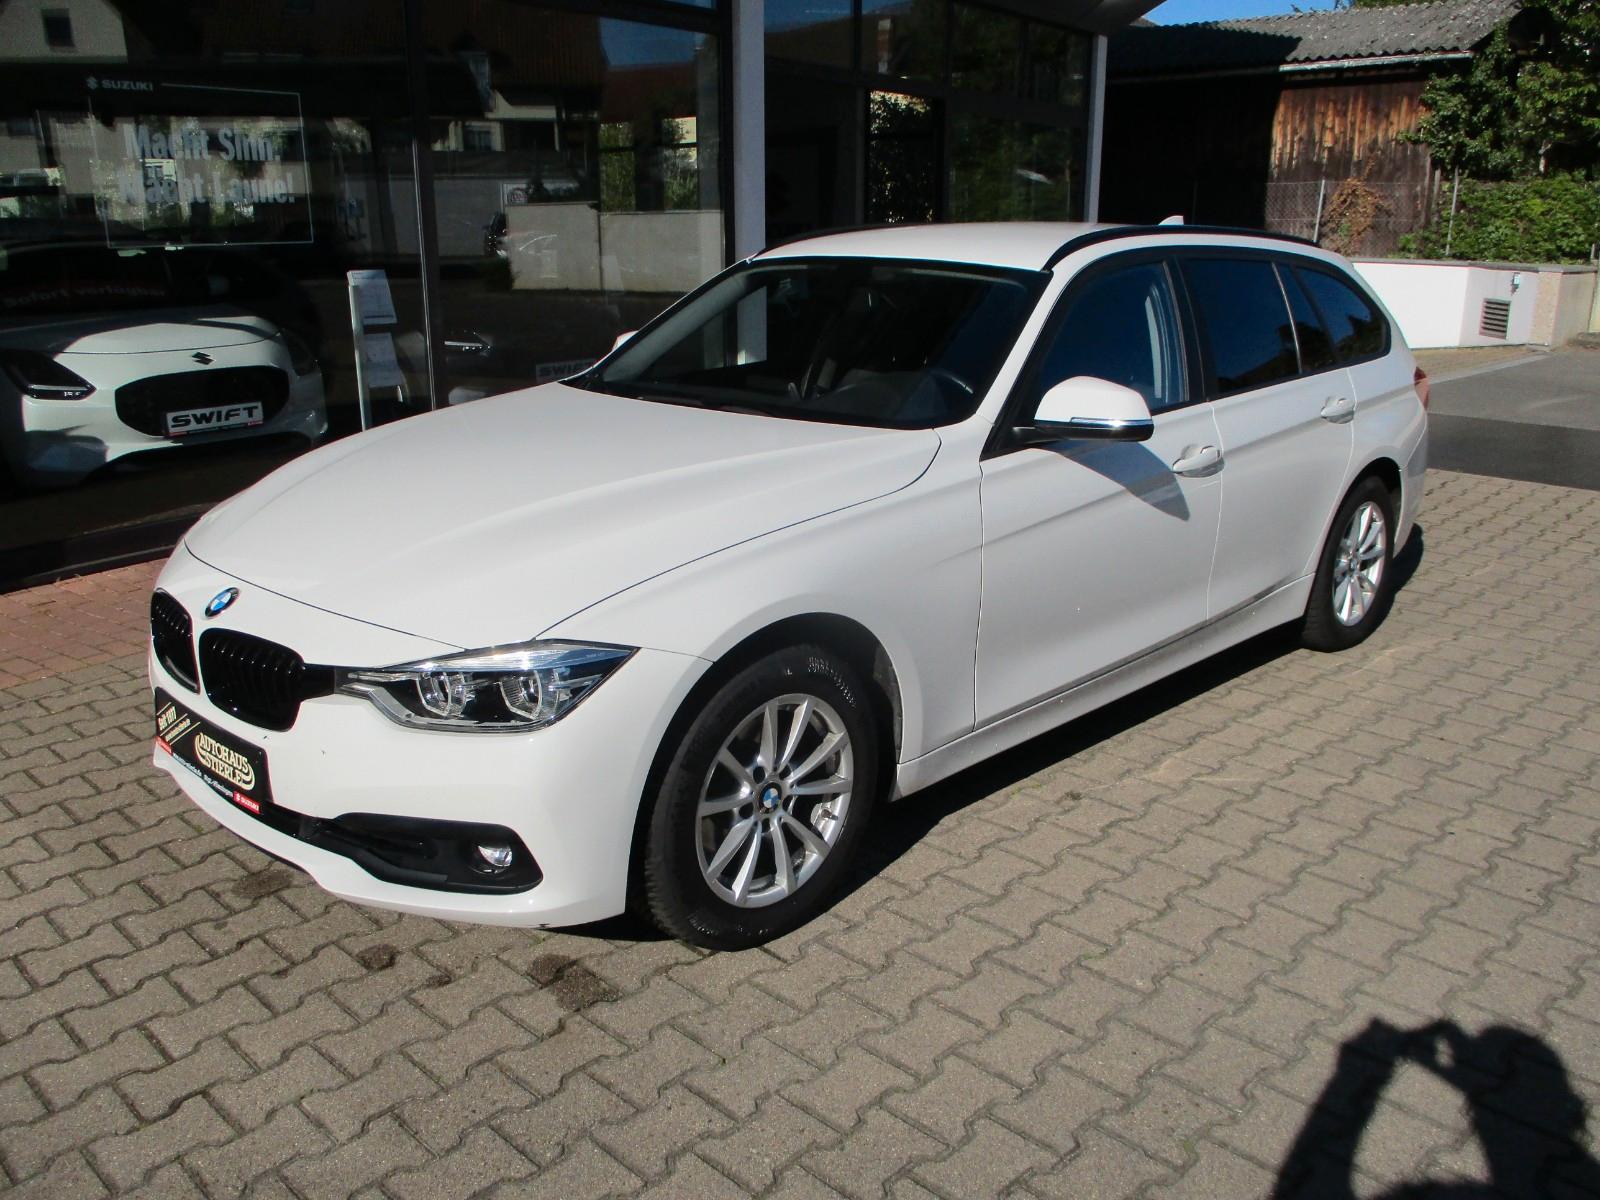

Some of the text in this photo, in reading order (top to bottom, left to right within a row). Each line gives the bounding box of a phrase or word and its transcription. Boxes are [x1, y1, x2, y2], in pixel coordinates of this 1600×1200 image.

[101, 79, 154, 92] SUZUKI
[123, 124, 210, 160] Macht
[119, 168, 206, 205] Macht
[171, 406, 258, 428] SWIFT
[199, 732, 249, 774] AUTOHAUS
[205, 753, 244, 785] STIERLE
